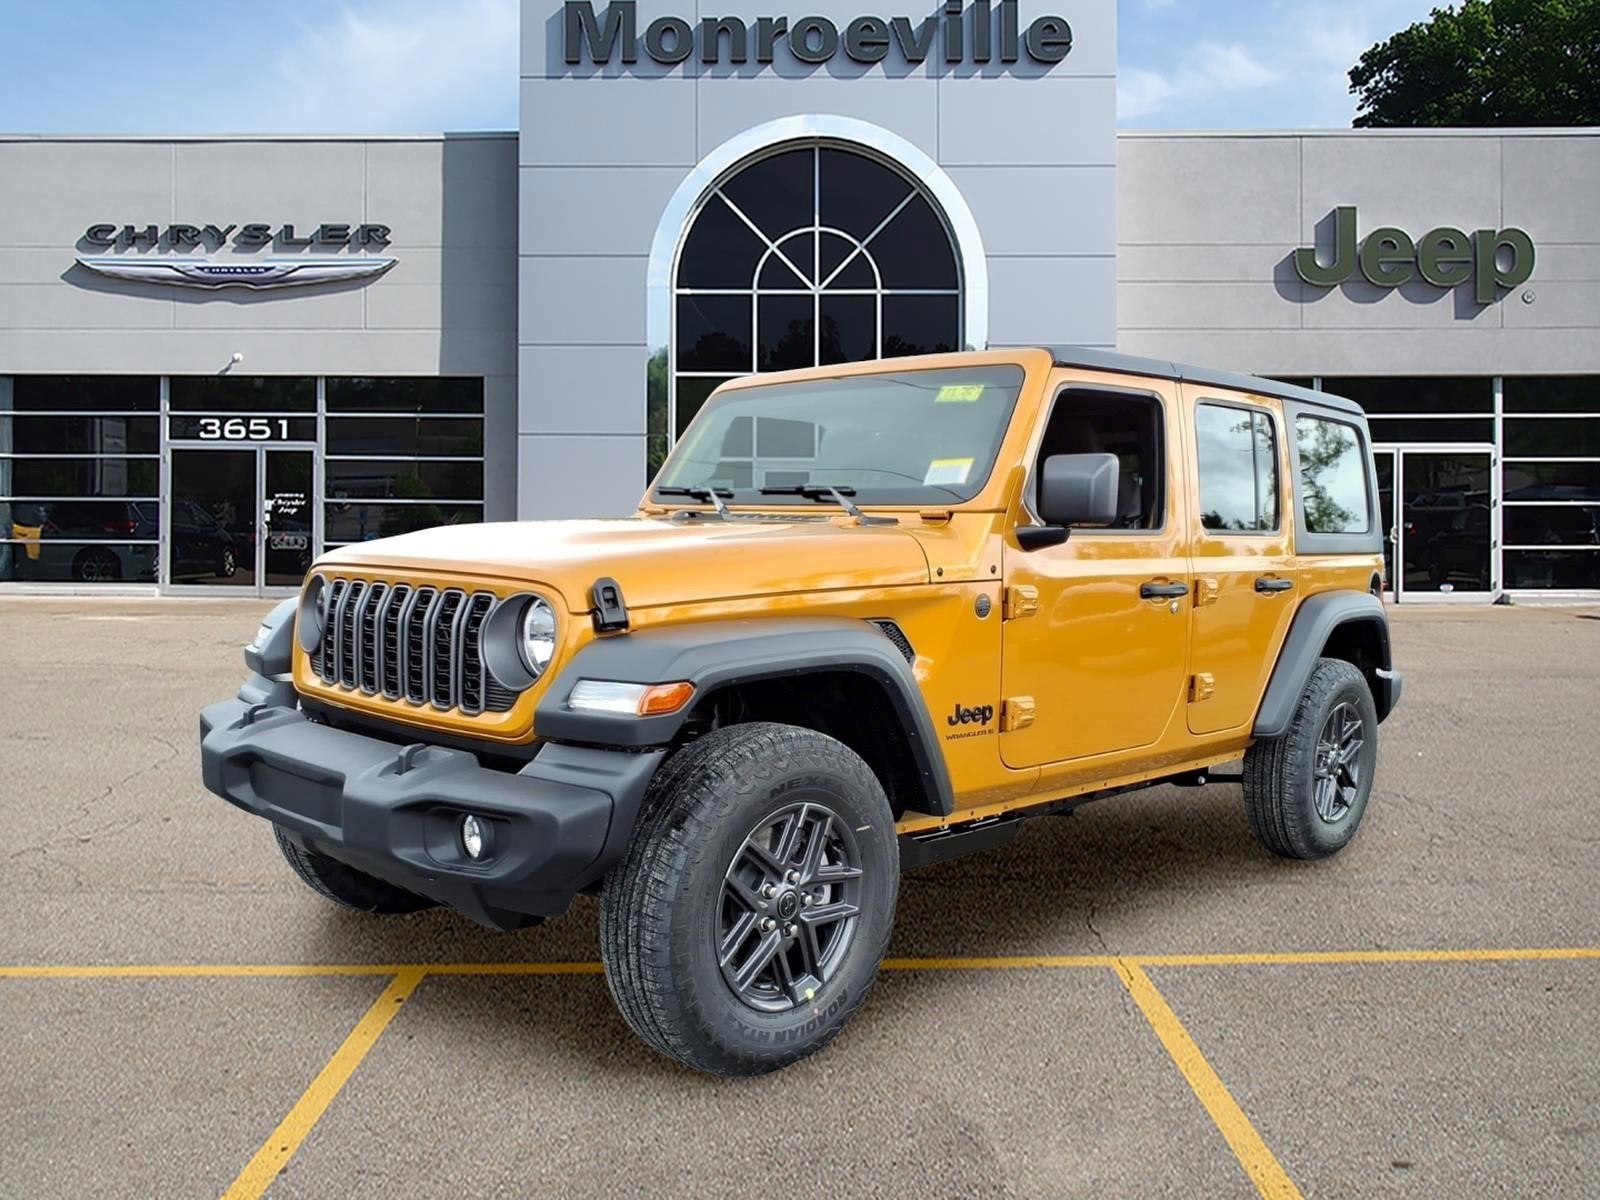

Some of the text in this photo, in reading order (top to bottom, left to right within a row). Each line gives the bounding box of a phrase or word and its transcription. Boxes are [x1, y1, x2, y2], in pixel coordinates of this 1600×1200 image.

[562, 0, 1074, 64] Monroeville
[85, 223, 392, 246] CHRYSLER
[1294, 206, 1536, 304] Jeep
[199, 418, 289, 440] 3651
[947, 703, 993, 726] Jeep
[945, 730, 987, 741] WRANGLER
